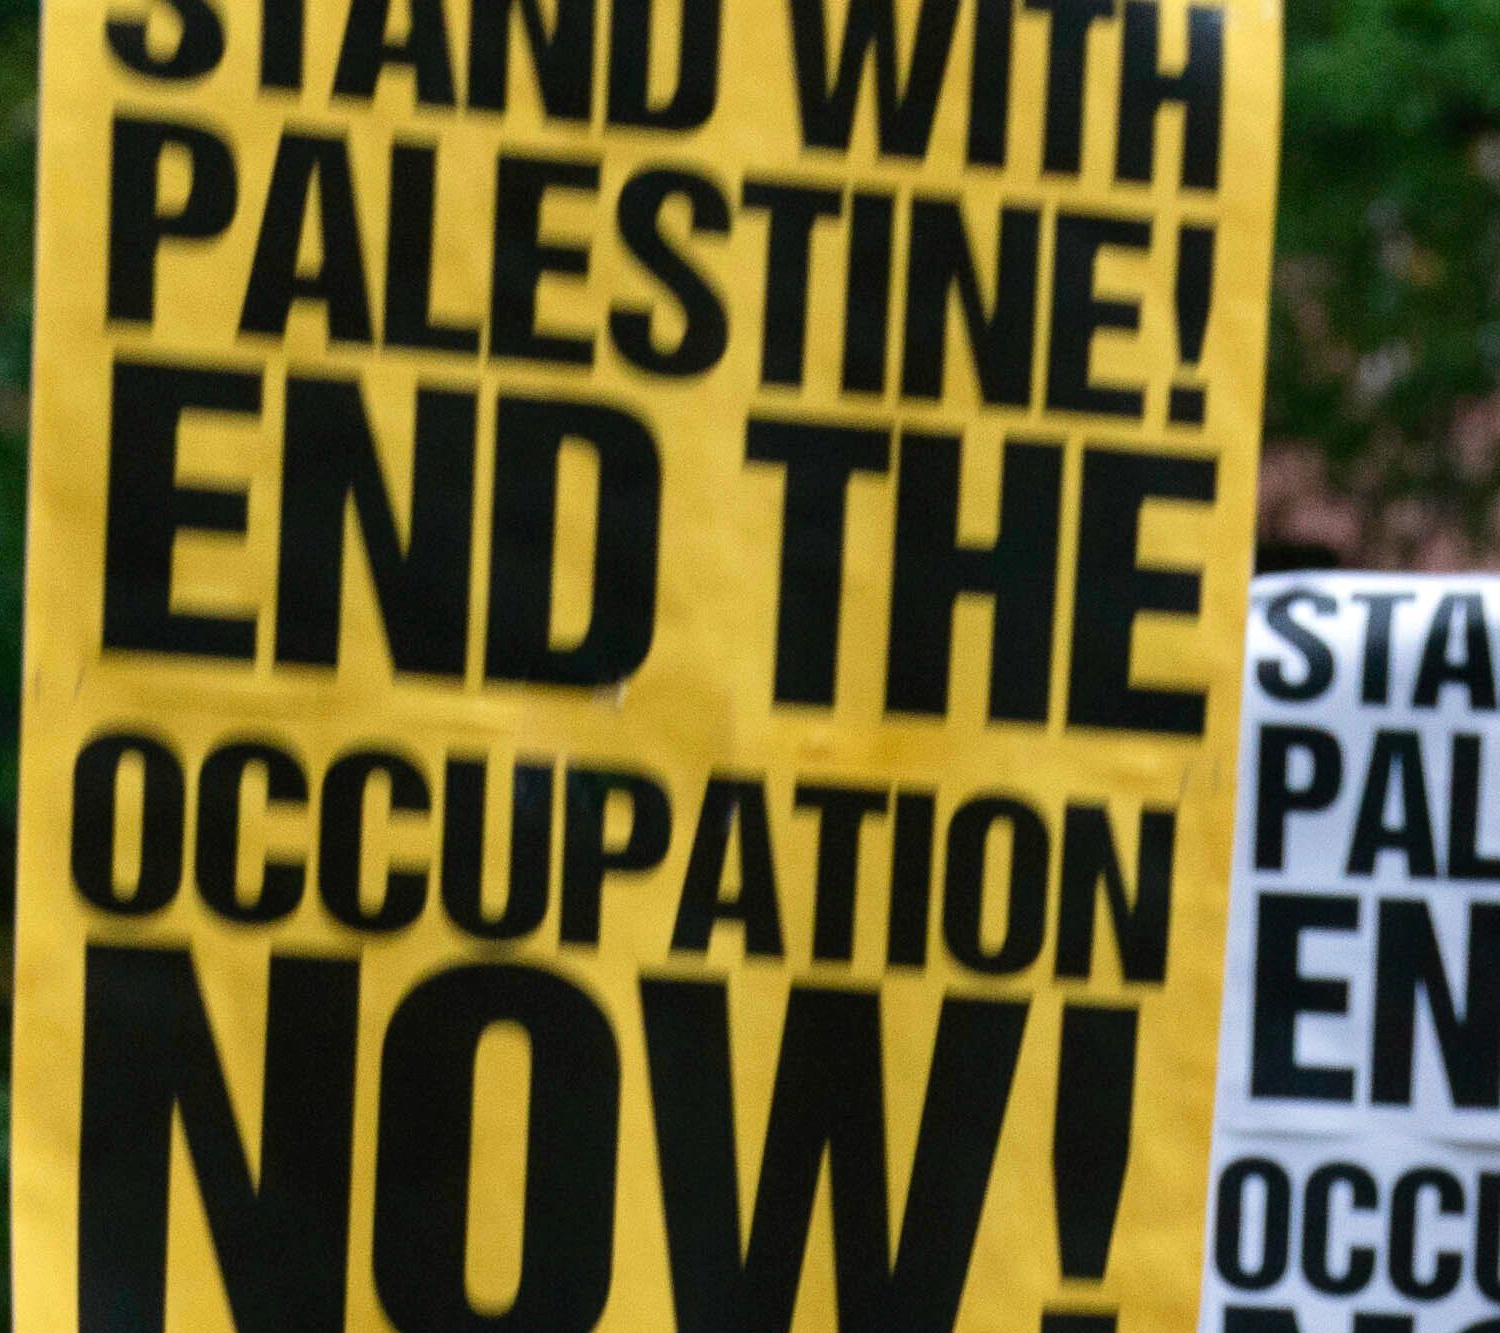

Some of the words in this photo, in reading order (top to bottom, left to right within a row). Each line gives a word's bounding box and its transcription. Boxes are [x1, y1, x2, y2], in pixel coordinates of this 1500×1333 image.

[788, 0, 1225, 191] WITH
[105, 108, 1217, 426] PALESTINE!
[100, 357, 664, 690] END
[744, 414, 1219, 737] THE
[69, 730, 1178, 986] OCCUPATION
